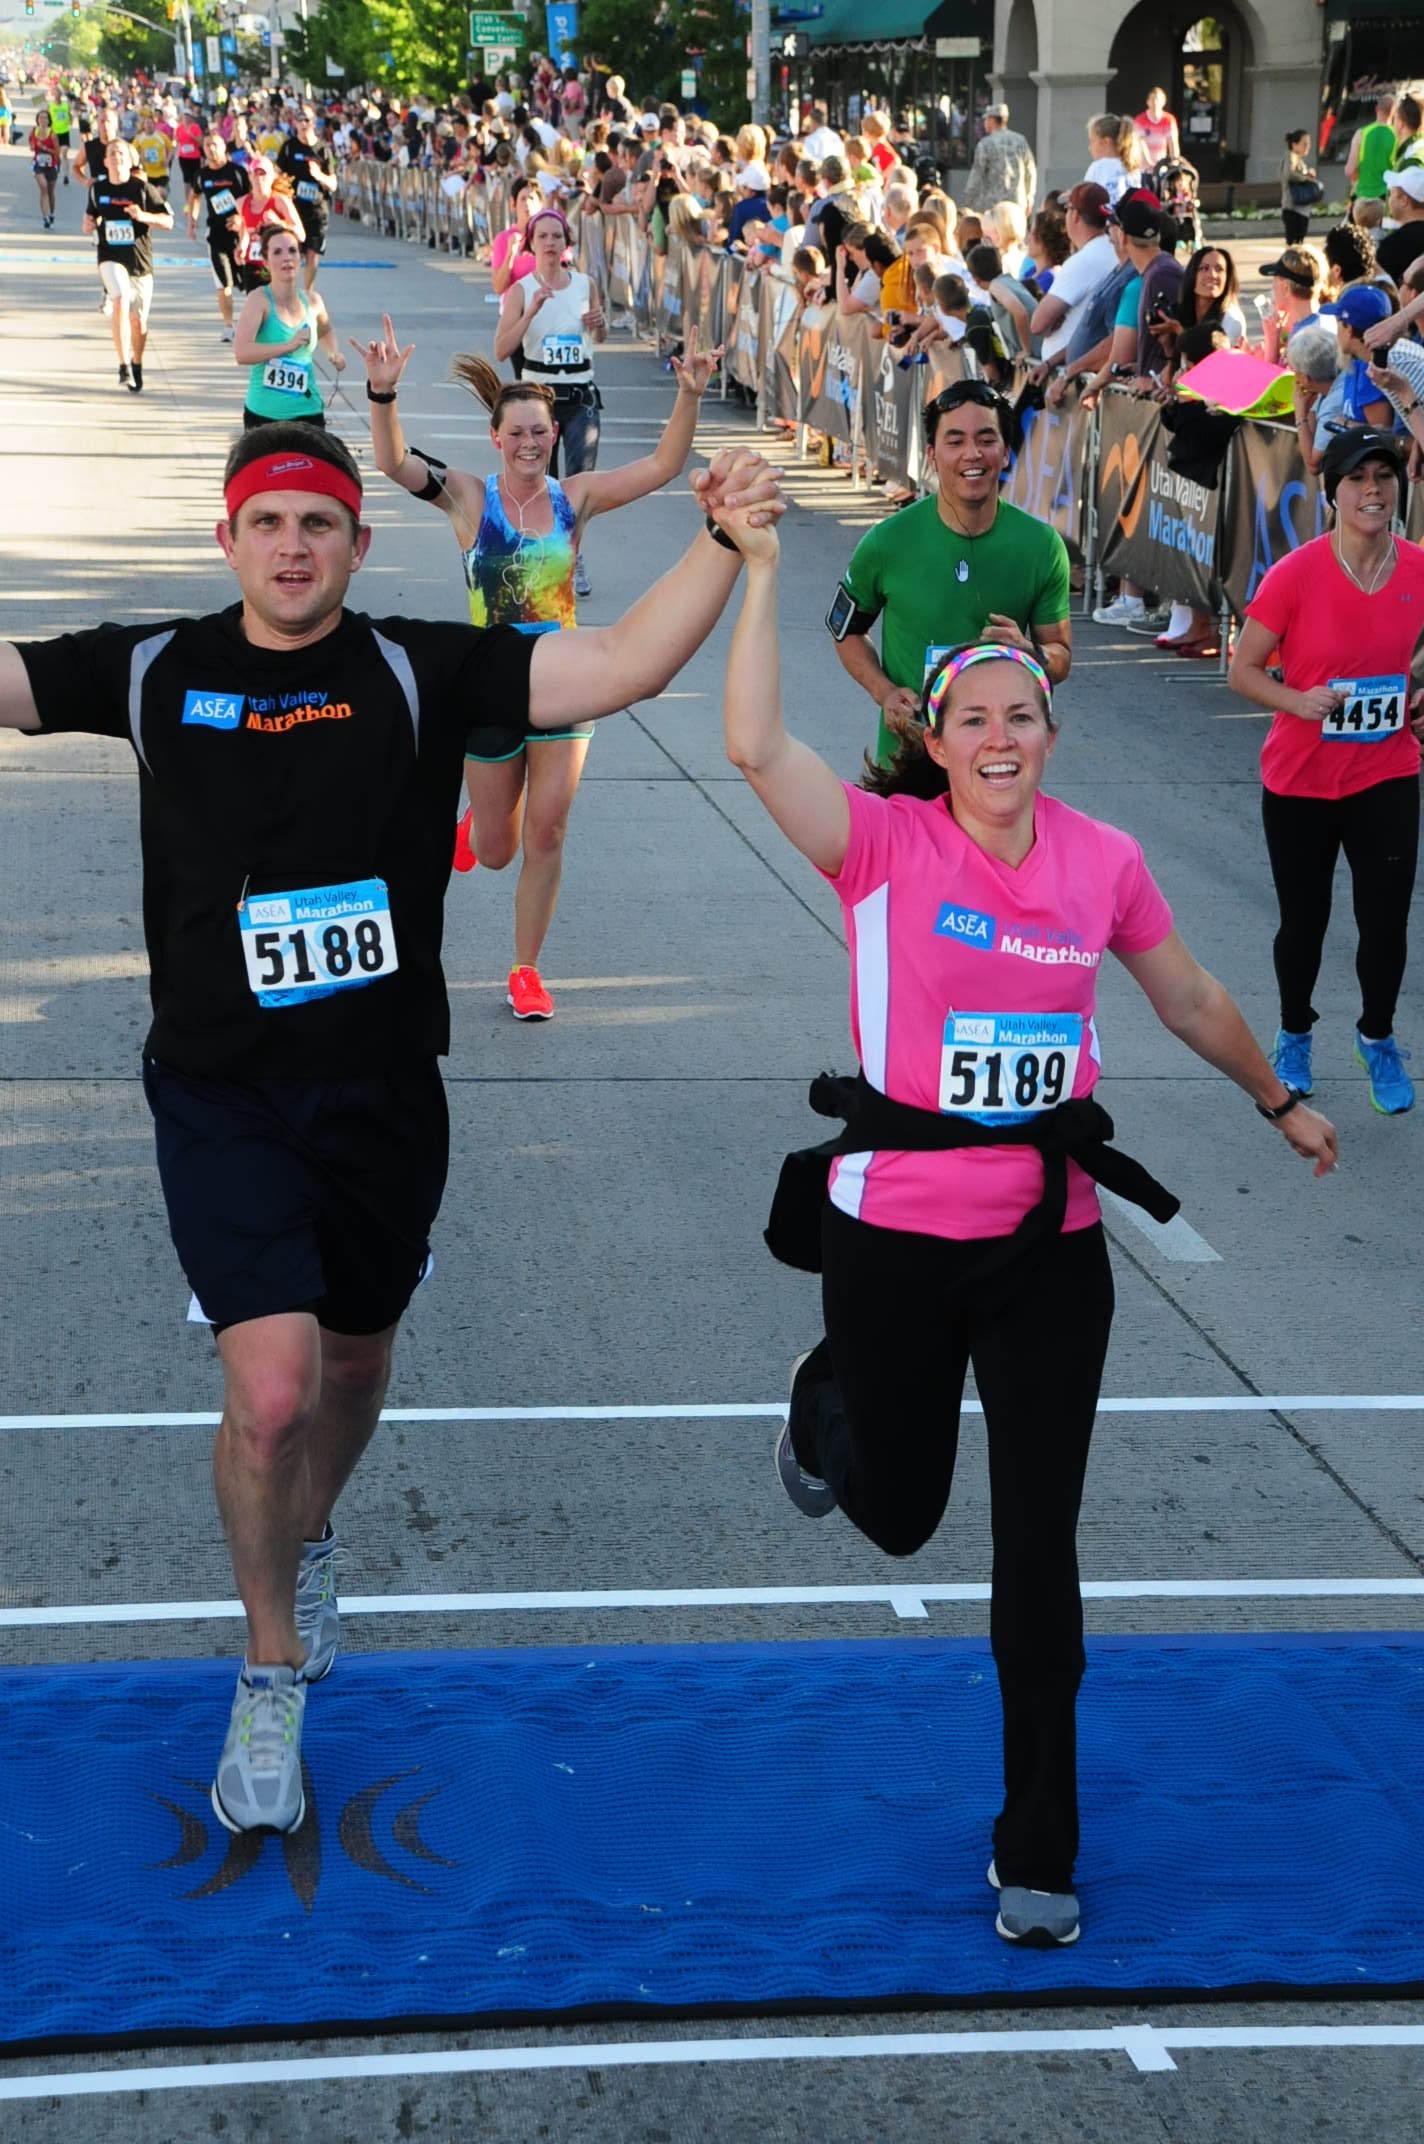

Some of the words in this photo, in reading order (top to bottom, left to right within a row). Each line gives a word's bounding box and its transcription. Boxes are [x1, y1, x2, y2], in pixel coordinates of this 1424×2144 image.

[267, 368, 304, 390] 4394
[279, 690, 328, 708] Valley
[1358, 685, 1398, 695] Marathon
[246, 703, 352, 732] Marathon
[1329, 696, 1398, 731] 4454
[294, 893, 322, 908] Utah
[324, 889, 357, 903] Valley
[296, 900, 374, 919] Marathon
[255, 919, 384, 985] 5188
[1000, 1019, 1026, 1031] Utah
[1027, 1019, 1057, 1032] Valley
[998, 1031, 1067, 1044] Marathon
[950, 1051, 1065, 1107] 5189
